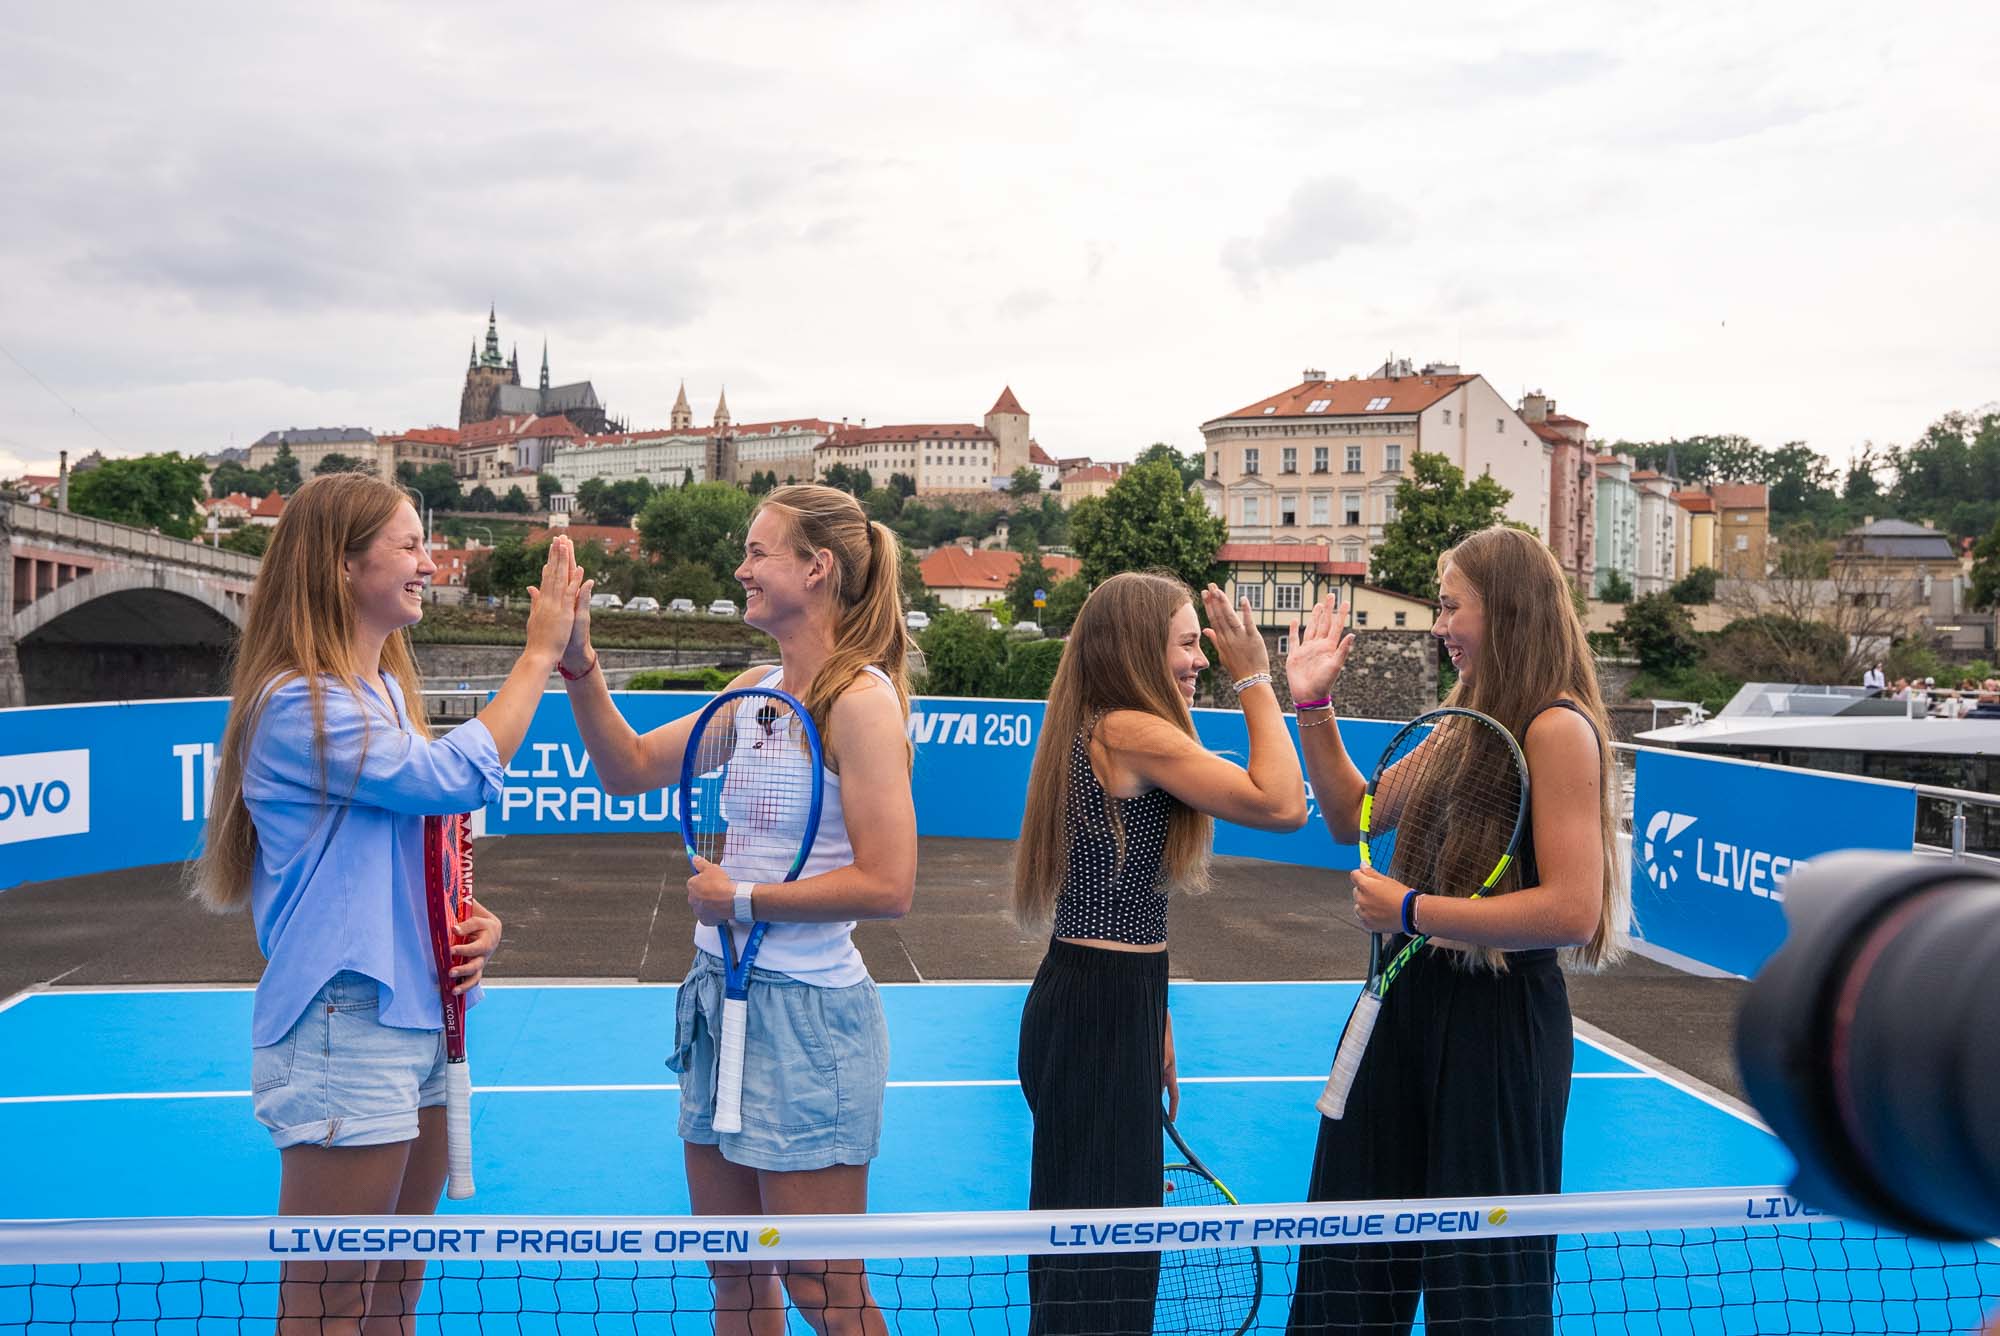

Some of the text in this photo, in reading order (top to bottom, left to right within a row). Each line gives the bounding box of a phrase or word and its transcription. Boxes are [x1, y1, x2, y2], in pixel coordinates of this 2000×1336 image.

[983, 713, 1032, 747] 250
[501, 786, 703, 822] PRAGUE
[446, 1003, 456, 1032] VCORE
[1746, 1197, 1821, 1219] LIV
[269, 1228, 749, 1253] LIVESPORT PRAGUE OPEN
[1050, 1210, 1480, 1247] LIVESPORT PRAGUE OPEN
